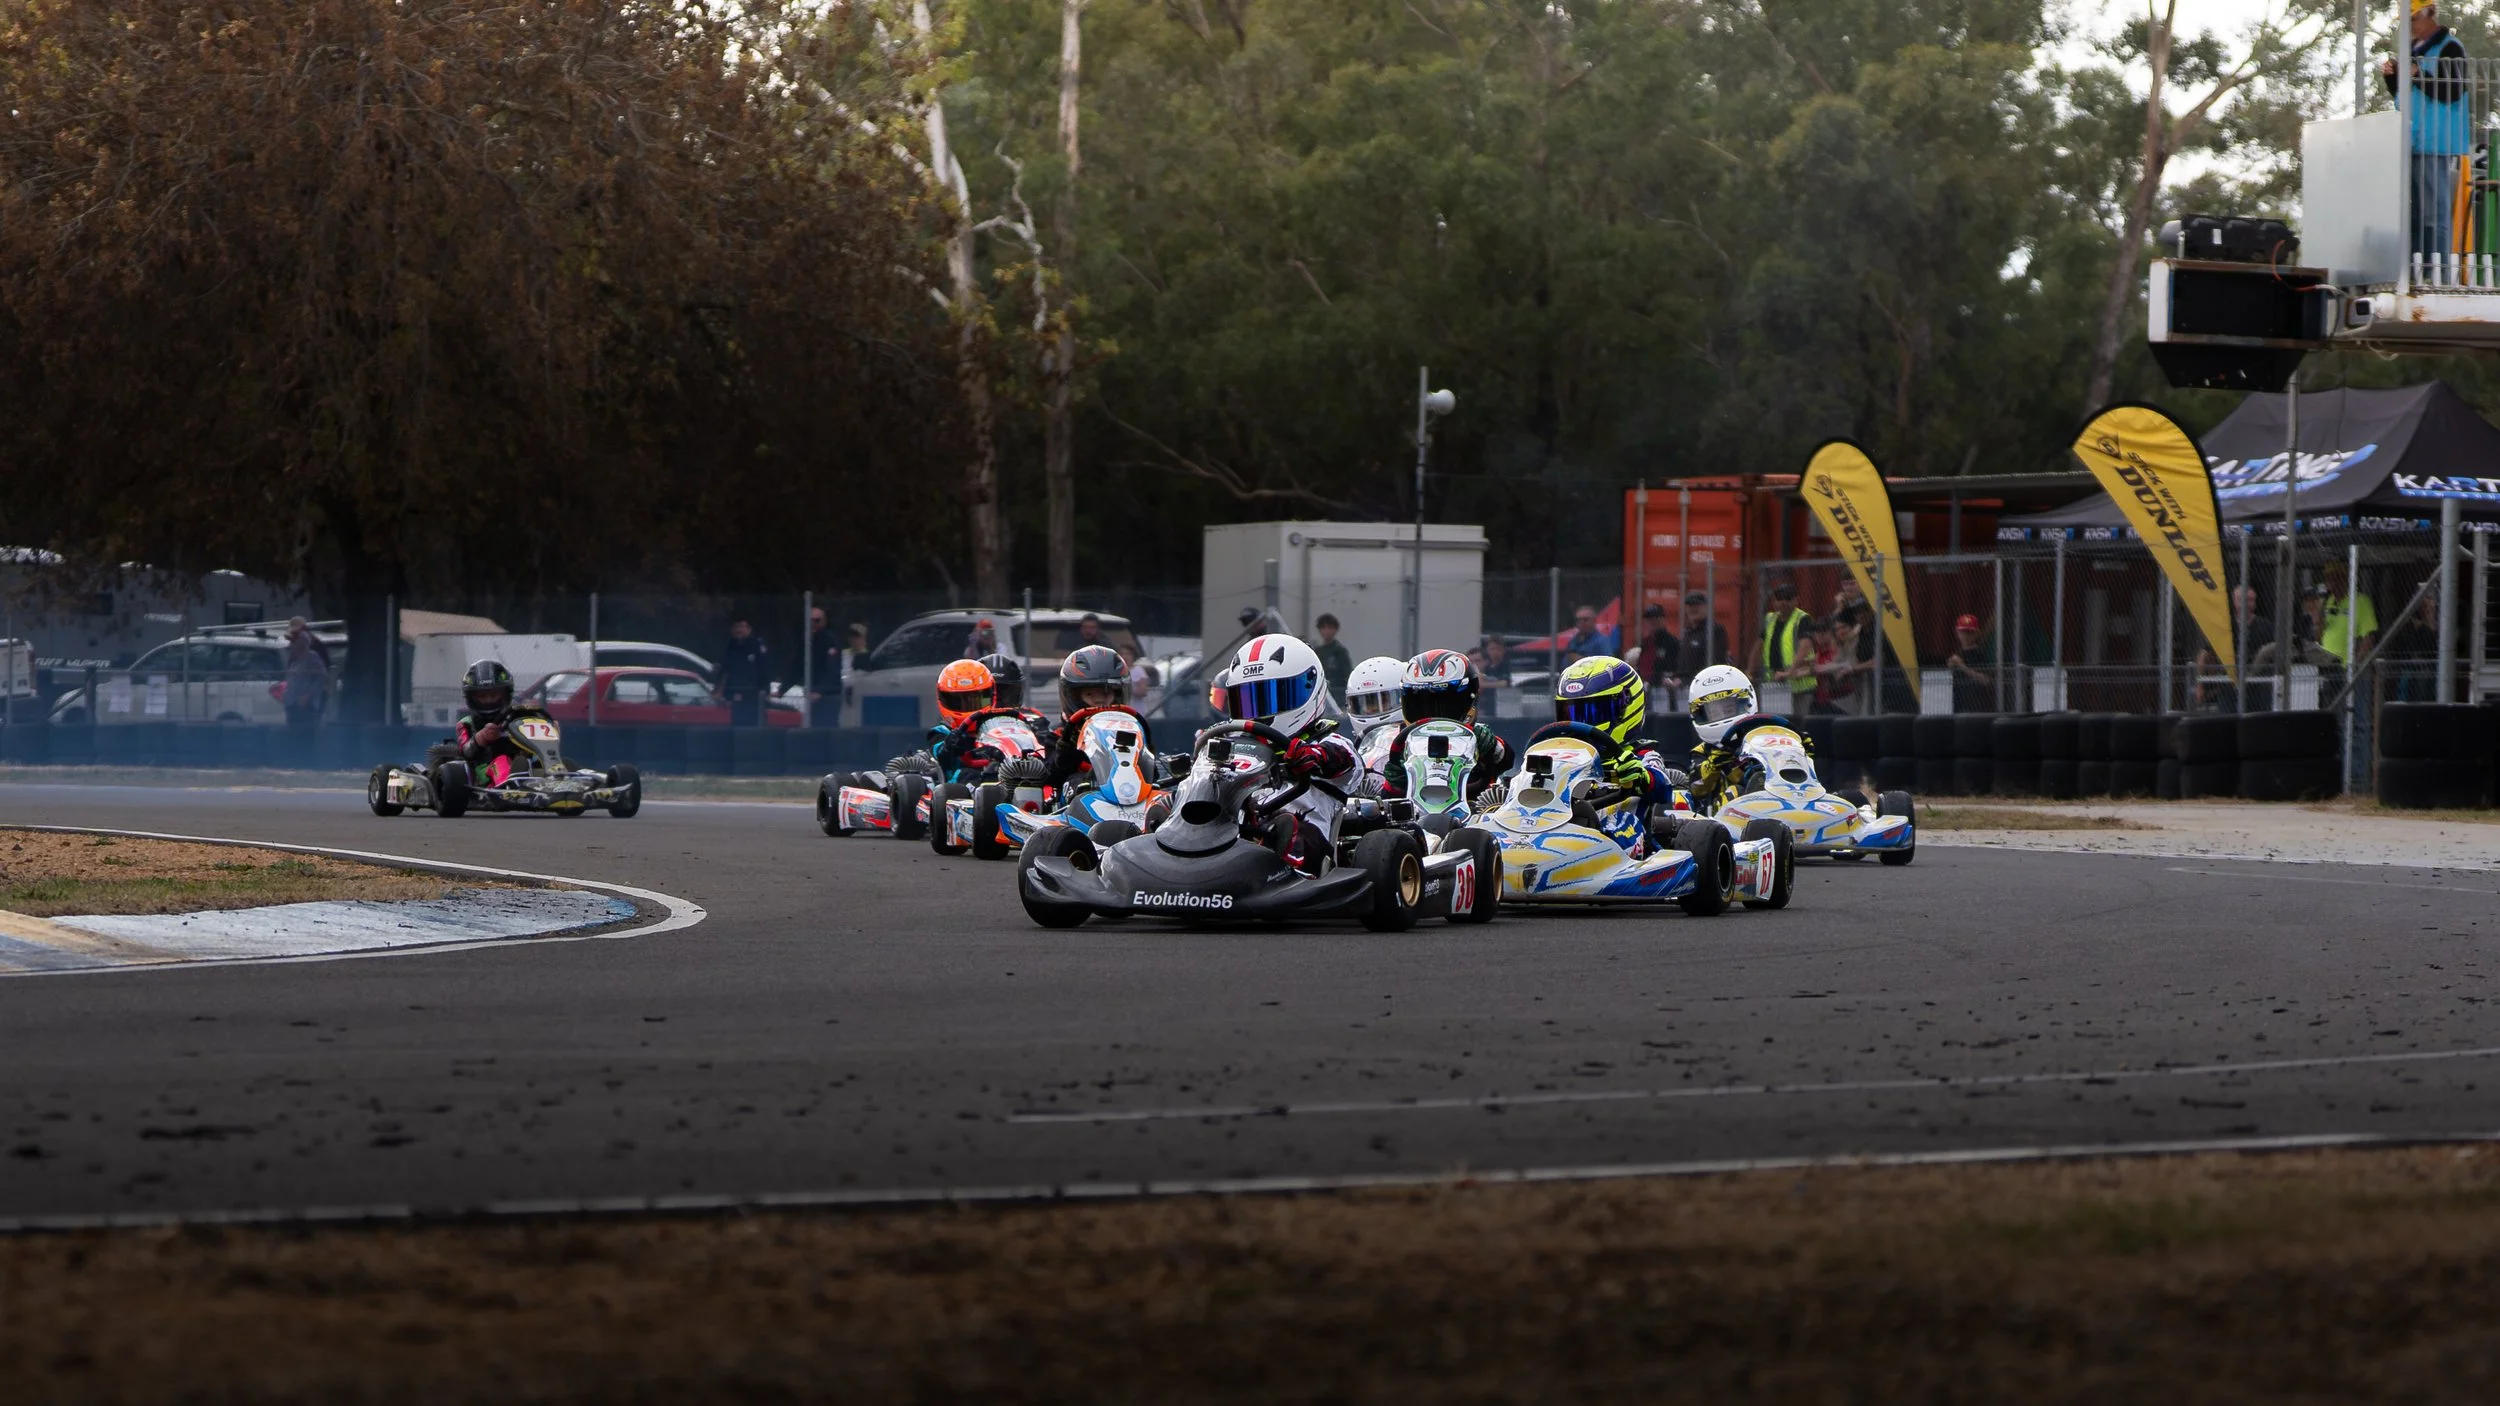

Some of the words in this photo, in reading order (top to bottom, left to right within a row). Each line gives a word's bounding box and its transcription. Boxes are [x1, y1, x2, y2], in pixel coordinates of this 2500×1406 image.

[2127, 452, 2164, 485] STICK
[2159, 488, 2186, 519] WITH
[1836, 487, 1860, 522] STICK
[1859, 524, 1878, 553] WITH
[2115, 465, 2217, 590] DUNLOP
[1243, 666, 1264, 676] OMP
[523, 724, 555, 738] 72
[1455, 864, 1475, 912] 30
[1759, 852, 1772, 896] 67
[1133, 890, 1233, 909] Evolution56
